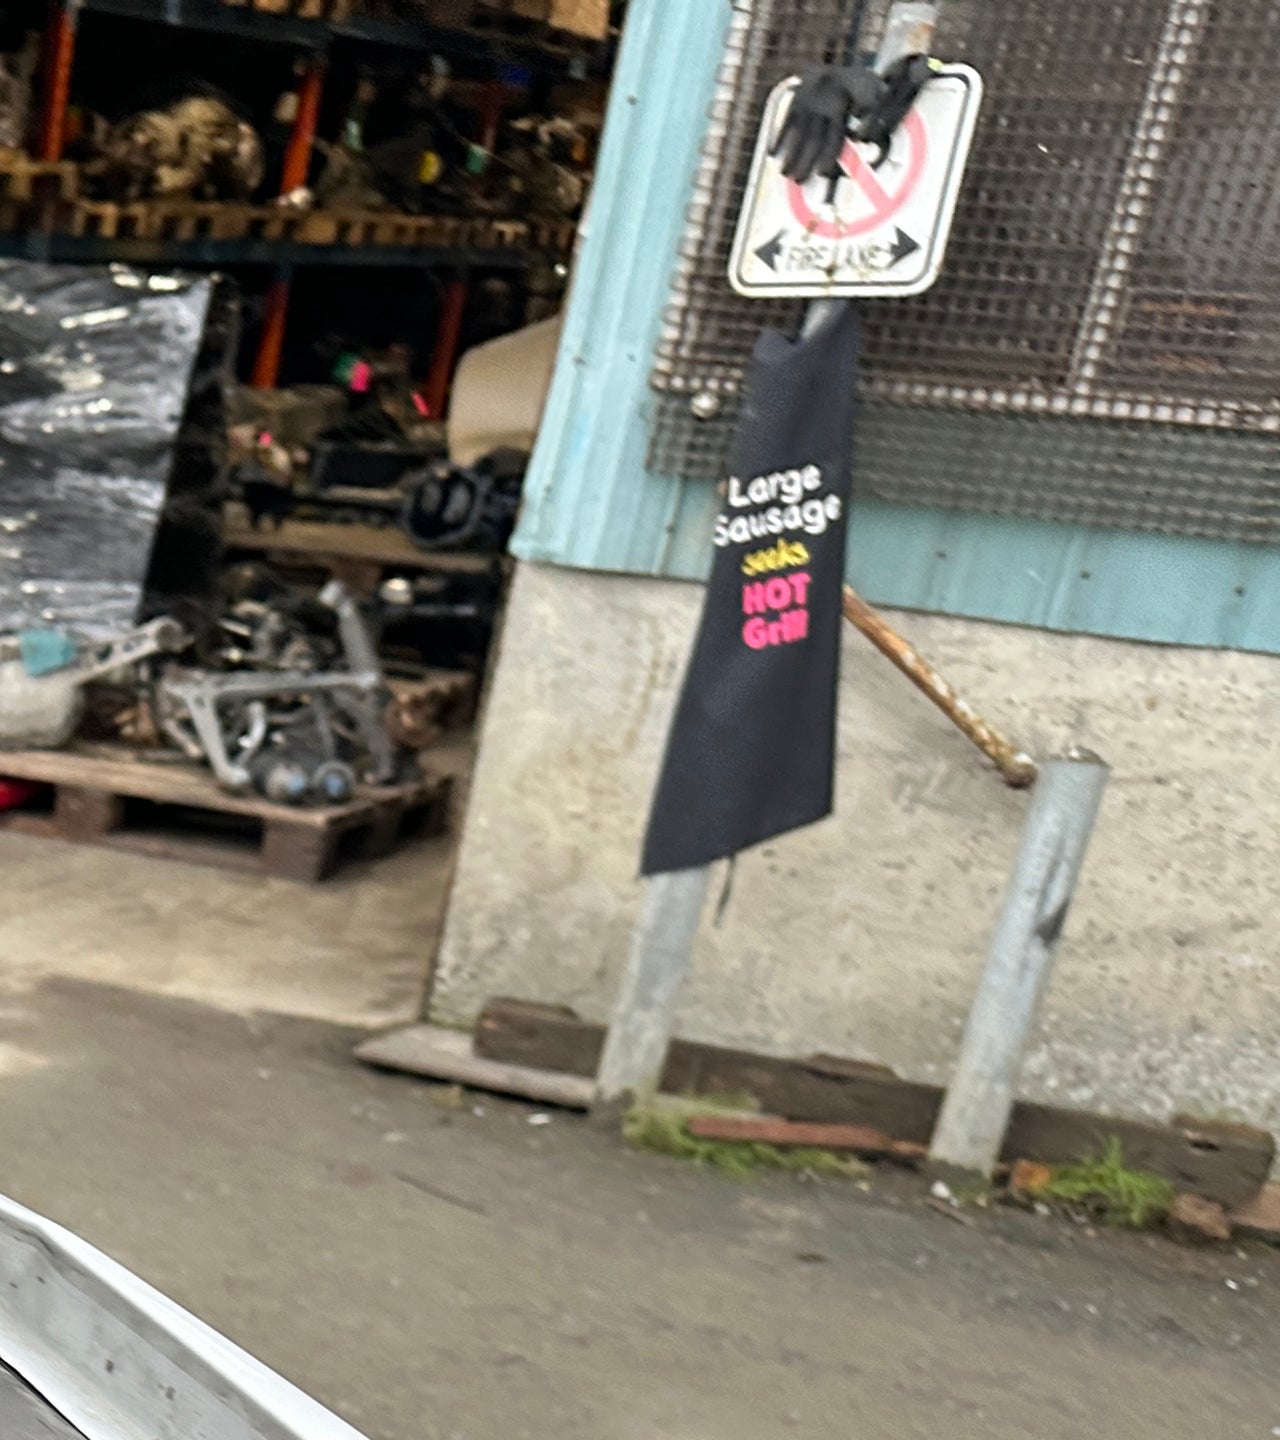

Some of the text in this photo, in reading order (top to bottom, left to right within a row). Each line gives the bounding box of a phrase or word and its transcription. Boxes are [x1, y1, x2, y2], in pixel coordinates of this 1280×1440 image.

[729, 465, 821, 507] Large
[713, 494, 841, 546] Sausage
[743, 573, 811, 615] HOT
[743, 609, 809, 649] Grill
